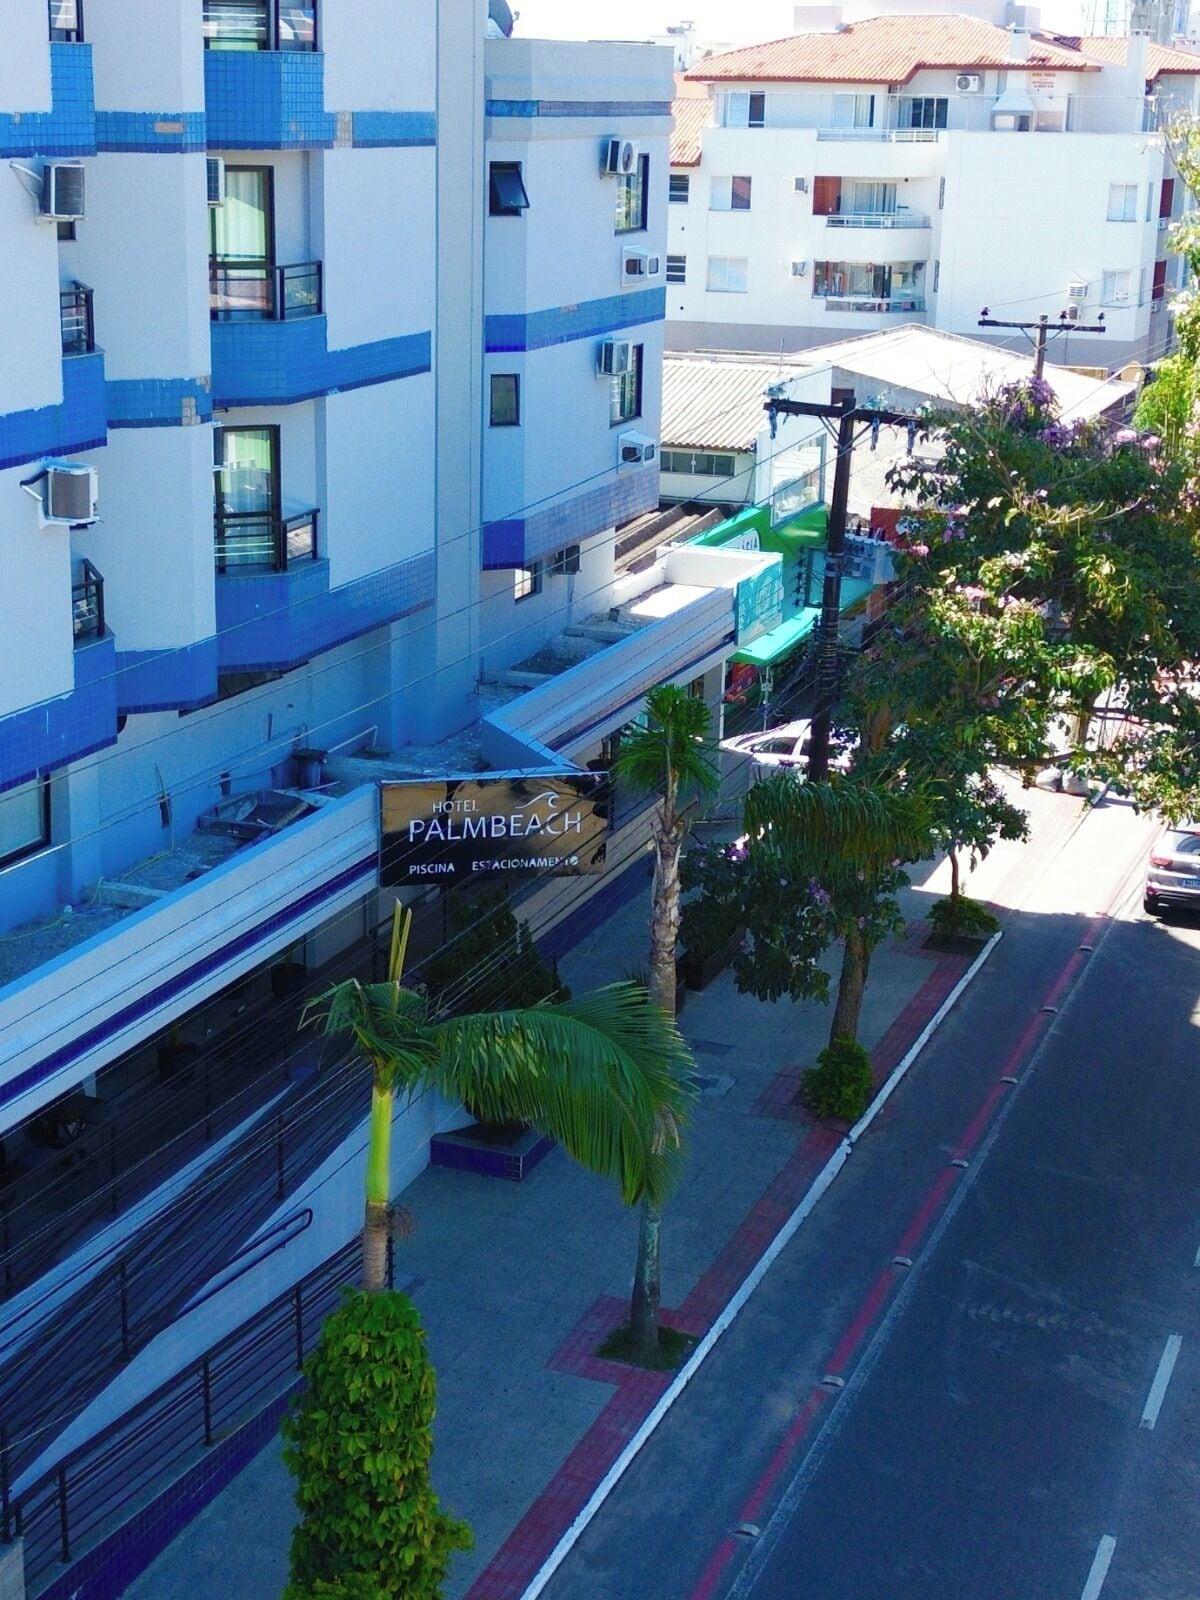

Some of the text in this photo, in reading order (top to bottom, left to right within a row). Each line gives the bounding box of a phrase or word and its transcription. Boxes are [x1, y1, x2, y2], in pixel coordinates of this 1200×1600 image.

[432, 799, 480, 813] HOTEL
[409, 812, 581, 842] PALMBEACH
[409, 862, 455, 875] PISCINA
